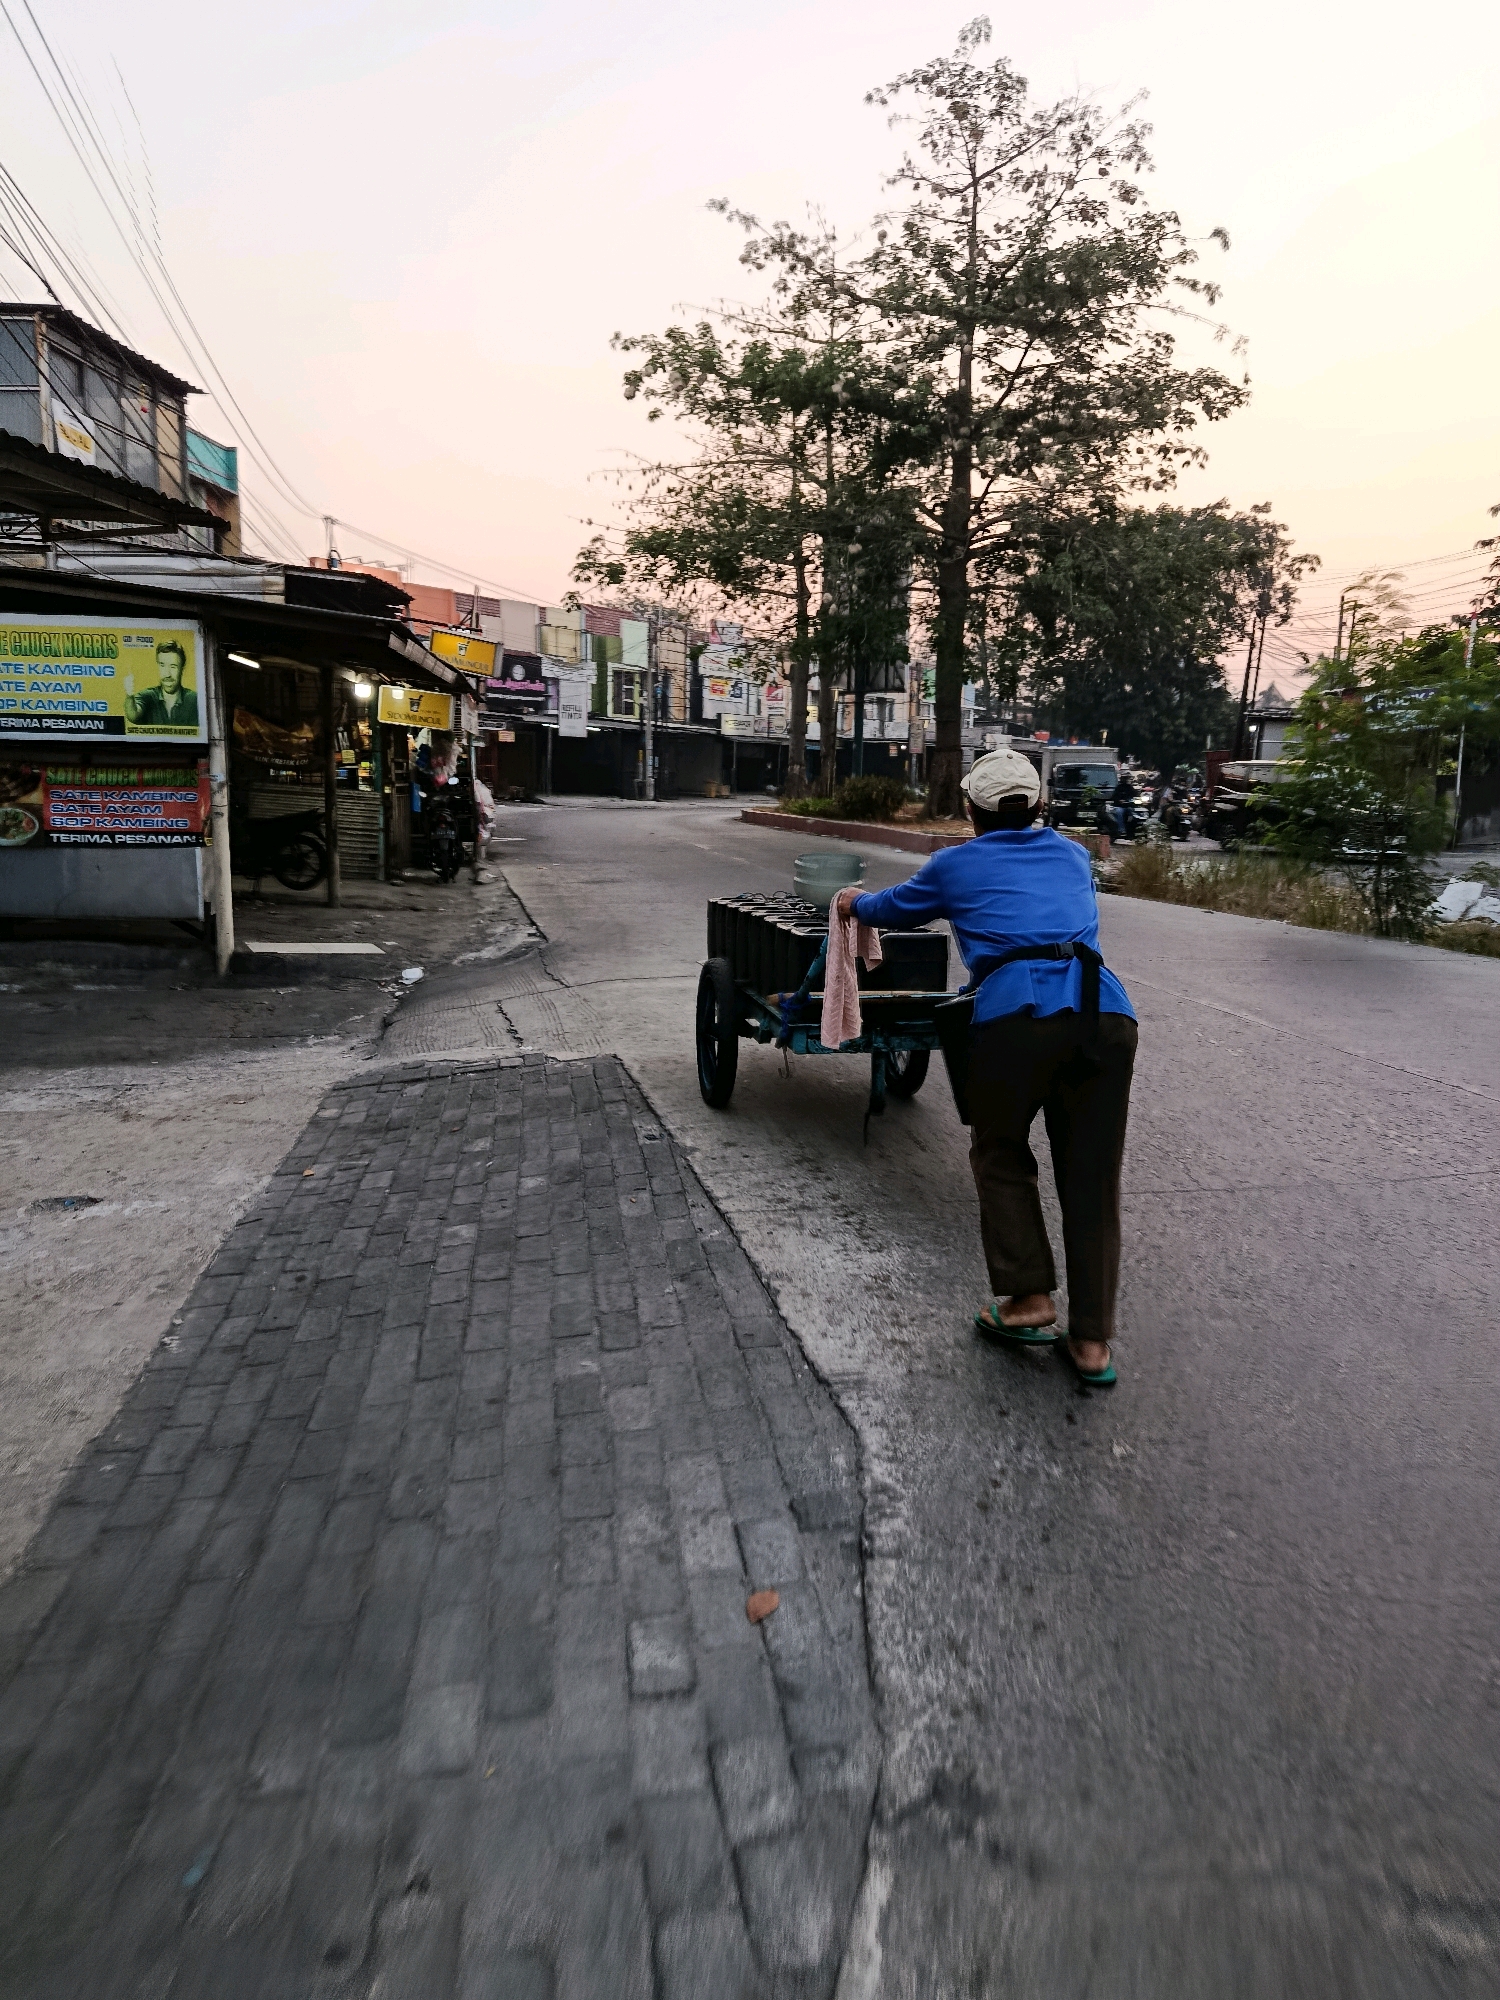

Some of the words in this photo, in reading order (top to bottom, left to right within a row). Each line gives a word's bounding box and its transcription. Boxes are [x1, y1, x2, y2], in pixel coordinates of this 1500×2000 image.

[10, 631, 61, 657] CHUCK
[62, 632, 119, 659] NORRIS
[28, 663, 115, 676] KAMBING
[29, 681, 82, 693] AYAM
[21, 699, 108, 712] KAMBING
[0, 717, 40, 728] ERIMA
[42, 718, 104, 729] PESANAN
[46, 767, 83, 785] SATE
[85, 767, 138, 786] CHUCK
[142, 768, 199, 787] NORRIS
[50, 790, 100, 801] SATE
[103, 791, 198, 802] KAMBING
[50, 804, 102, 814] SATE
[105, 805, 162, 815] AYAM
[50, 817, 92, 827] SOP
[96, 818, 189, 828] KAMBING
[50, 833, 112, 843] TERIMA
